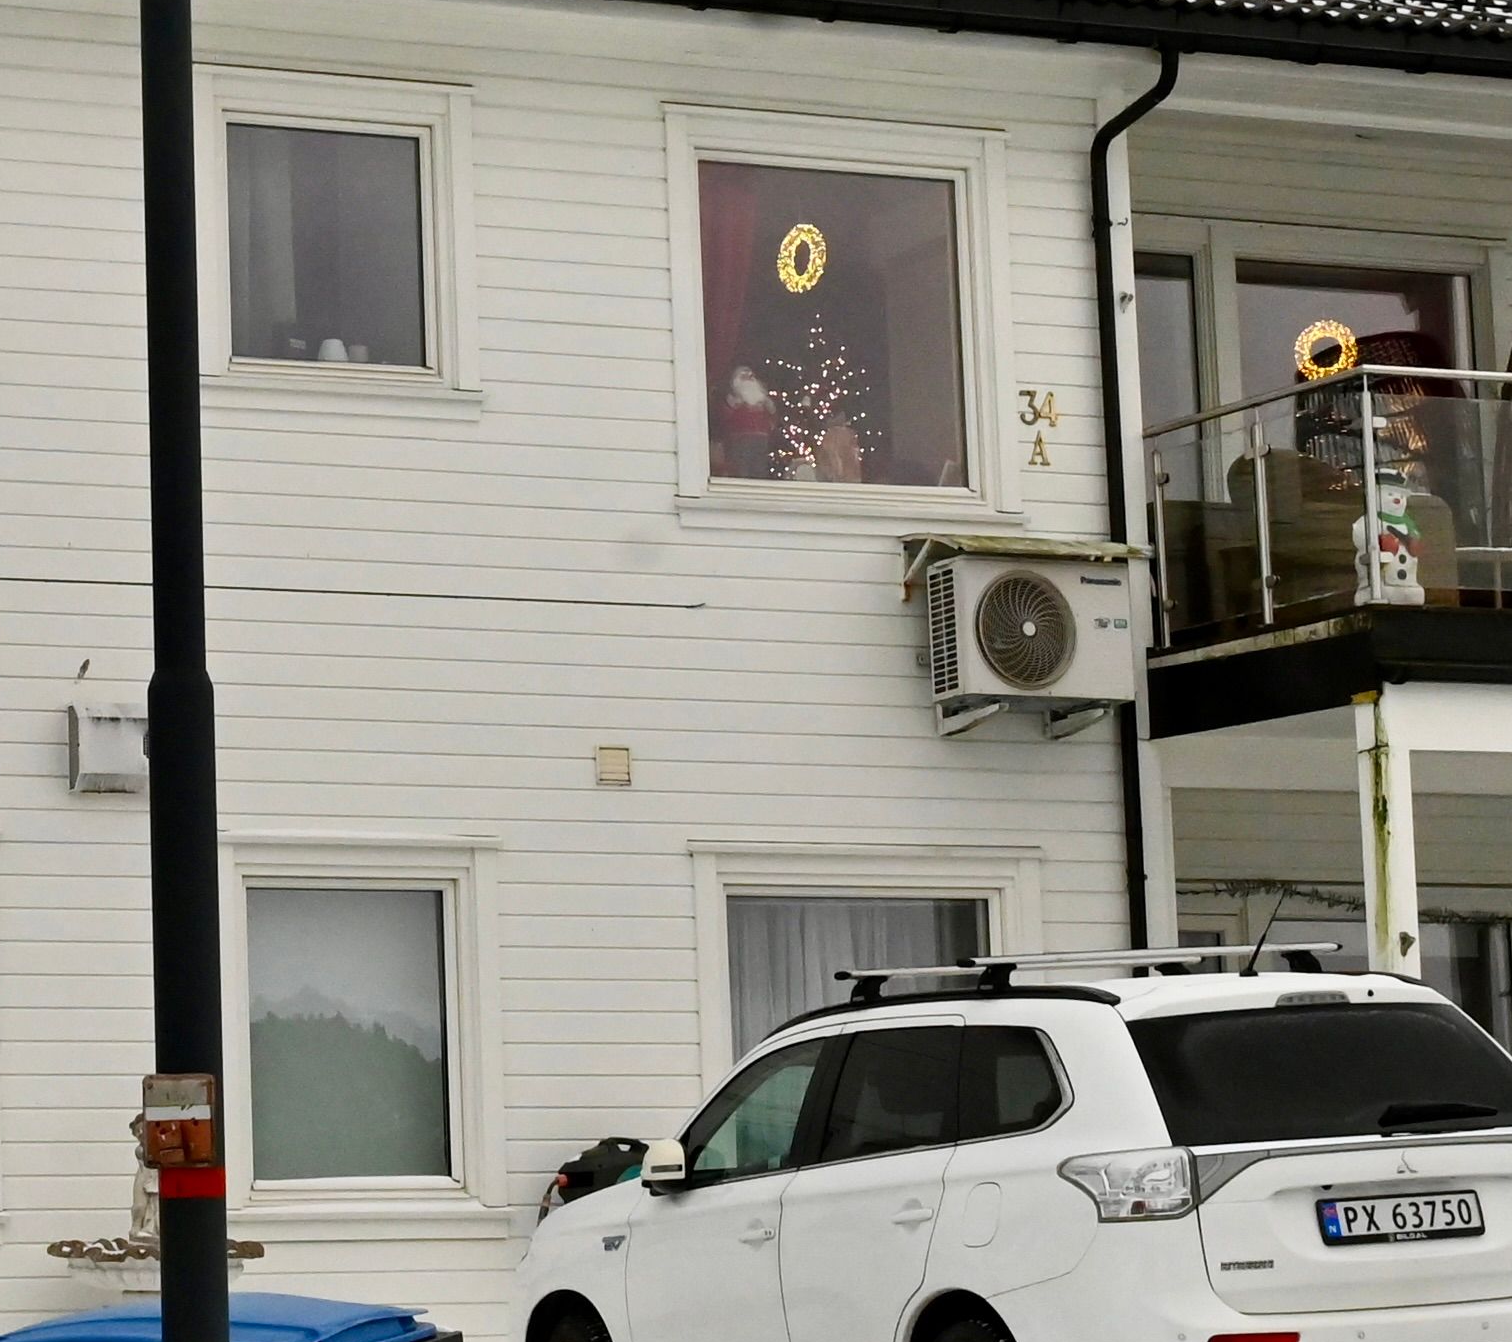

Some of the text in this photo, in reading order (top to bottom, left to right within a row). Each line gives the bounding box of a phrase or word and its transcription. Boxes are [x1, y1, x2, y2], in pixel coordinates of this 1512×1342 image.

[1019, 390, 1057, 427] 34
[1028, 430, 1051, 466] A
[1328, 1225, 1337, 1234] N
[1343, 1198, 1472, 1233] PX 63750
